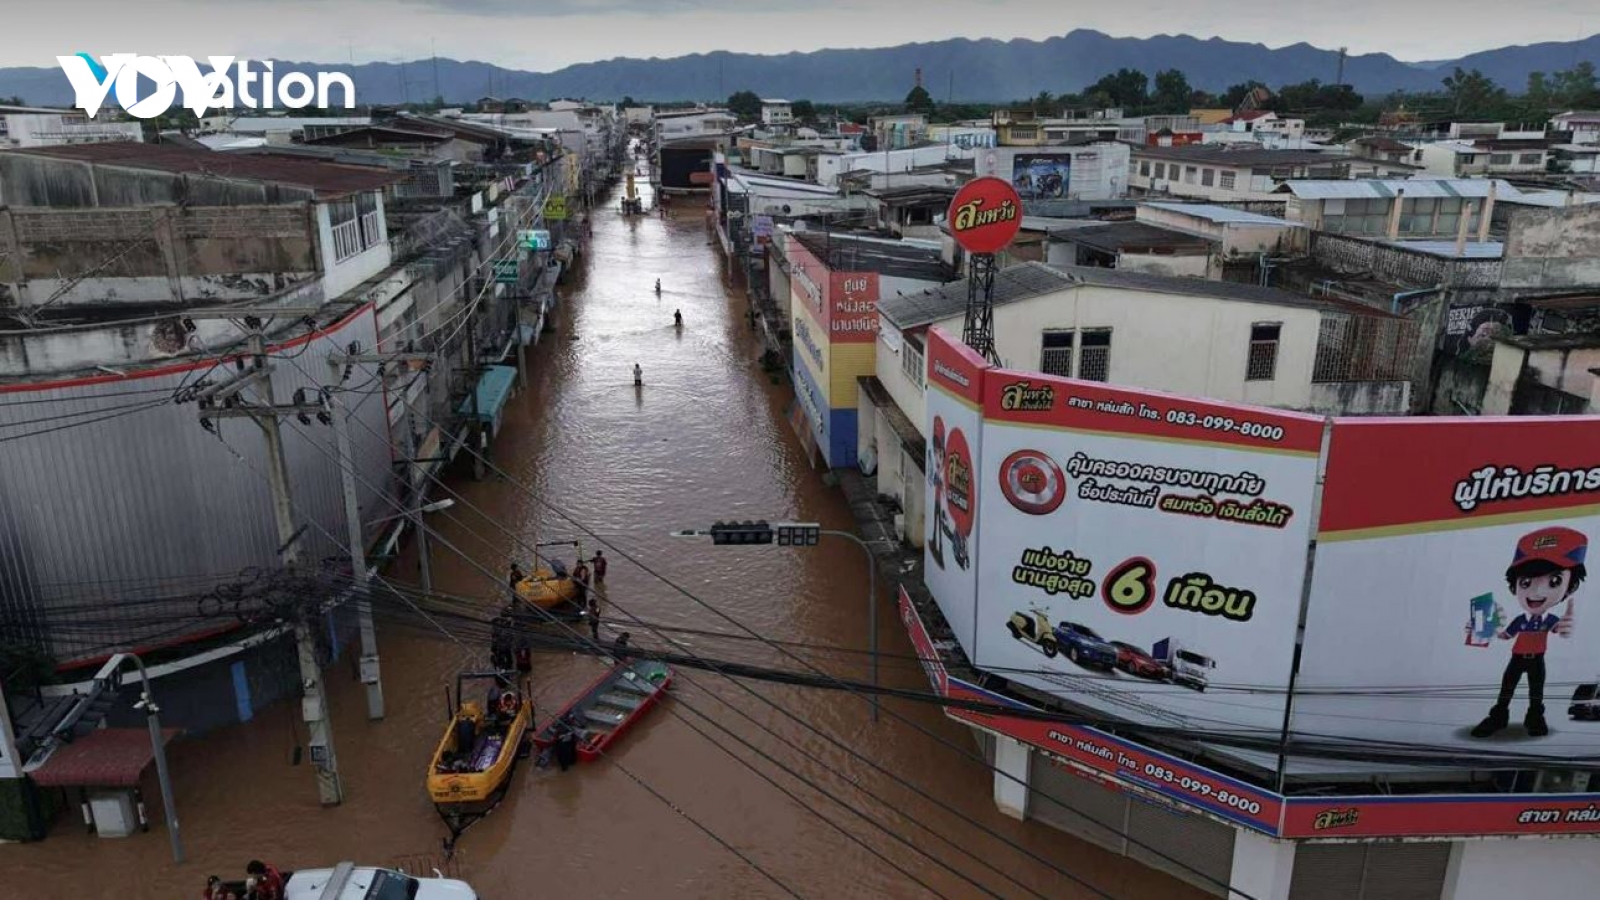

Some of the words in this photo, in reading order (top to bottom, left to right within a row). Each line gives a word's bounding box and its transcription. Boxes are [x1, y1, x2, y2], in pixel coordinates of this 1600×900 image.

[954, 198, 1017, 231] สมหวัง
[1067, 396, 1094, 410] สาขา
[1096, 399, 1135, 416] หล่มสัก
[1138, 405, 1161, 420] โทร.
[1166, 409, 1285, 441] 083-099-8000
[1067, 452, 1265, 496] คุ้มครองครบจบทุกภัย
[1079, 482, 1159, 509] ซื้อประกันที่
[1161, 496, 1214, 517] สมหวัง
[1218, 497, 1288, 527] เงินสั่งได้
[1014, 566, 1095, 600] นานสูงสุด
[1022, 547, 1091, 575] แบ่งจ่าย
[1109, 563, 1149, 608] 6
[1167, 575, 1253, 619] เดือน
[1048, 730, 1074, 746] สาขา
[1076, 738, 1115, 761] หล่มสัก
[1117, 751, 1140, 772] โทร.
[1144, 763, 1261, 815] 083-099-8000
[1518, 808, 1560, 824] สาขา
